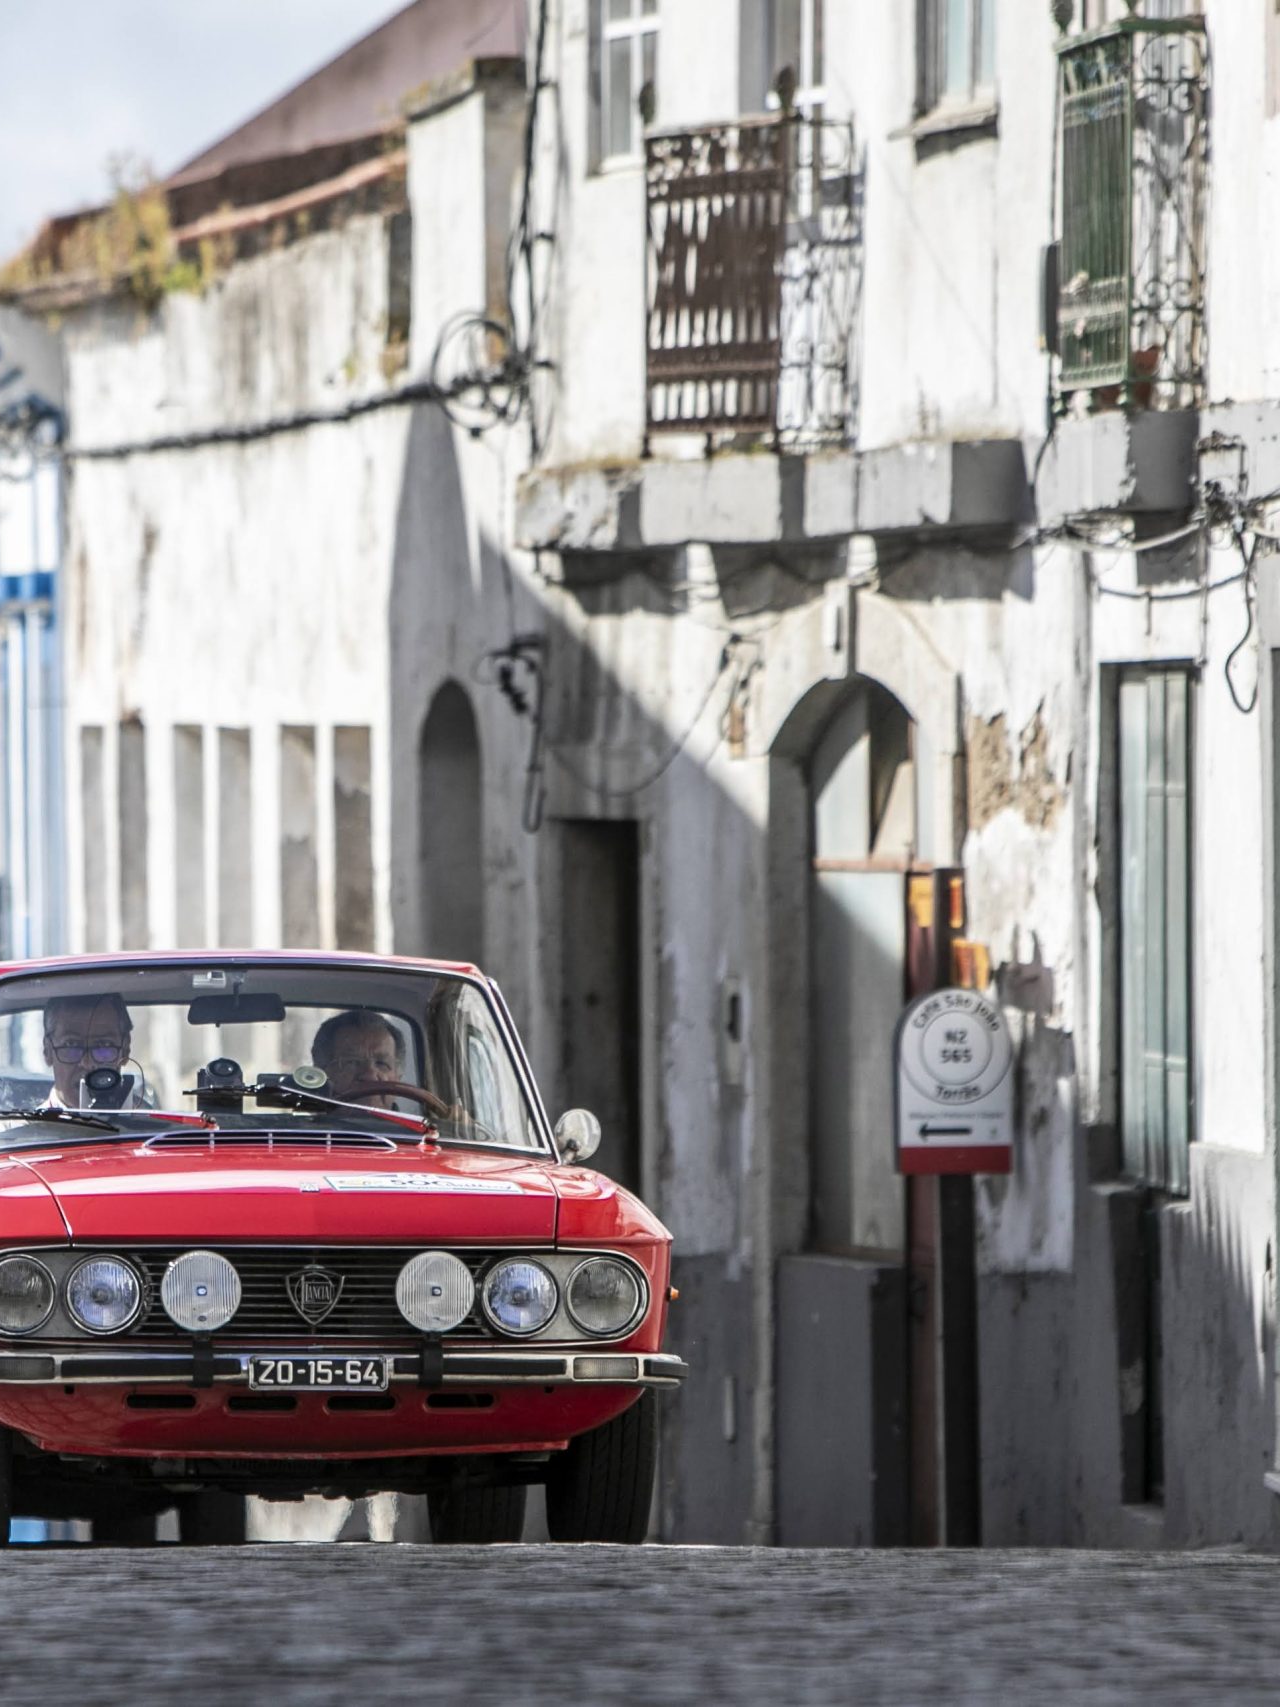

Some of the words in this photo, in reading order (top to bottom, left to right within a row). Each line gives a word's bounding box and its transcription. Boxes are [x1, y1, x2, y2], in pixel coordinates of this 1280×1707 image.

[940, 1048, 973, 1064] 565
[304, 1282, 331, 1303] LANCIA
[258, 1360, 380, 1385] ZO-15-64
